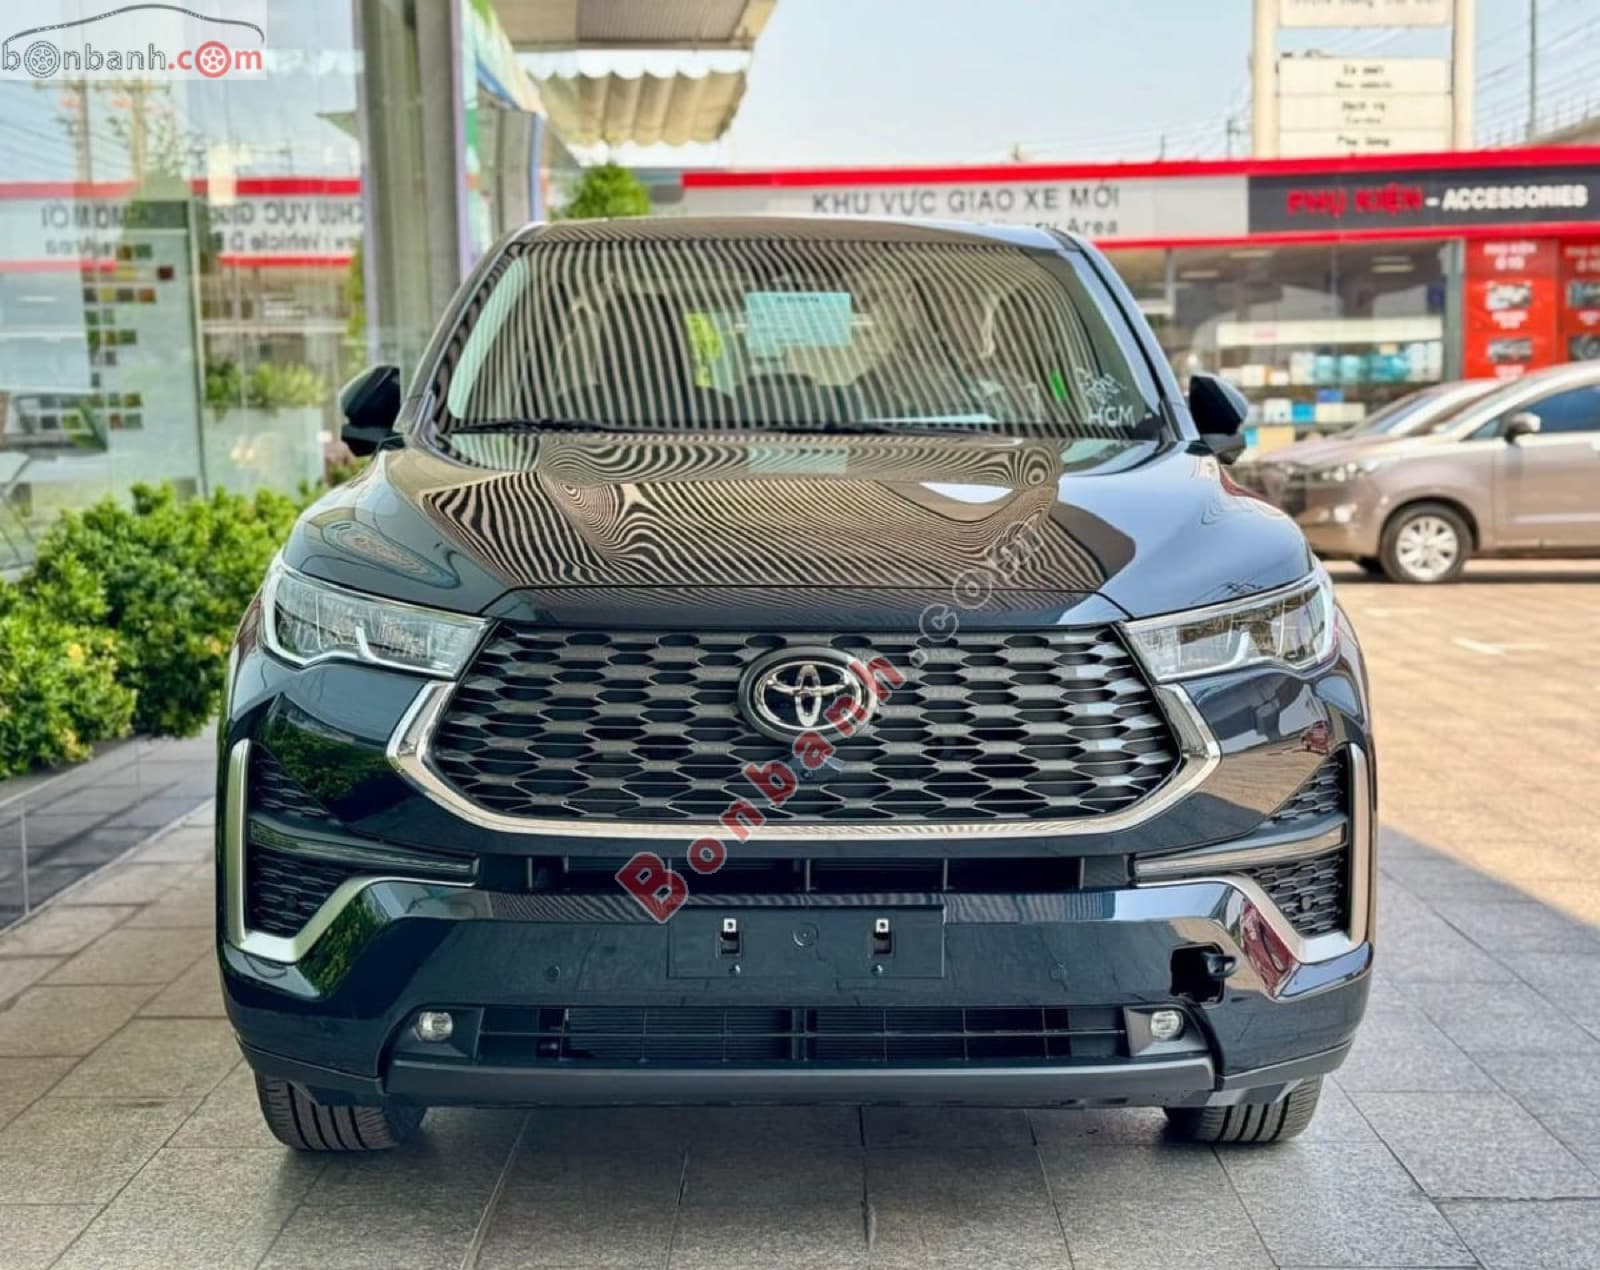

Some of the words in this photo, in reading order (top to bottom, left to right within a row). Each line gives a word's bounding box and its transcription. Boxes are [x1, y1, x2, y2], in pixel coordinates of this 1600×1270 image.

[812, 192, 870, 214] KHU
[882, 190, 937, 216] VỰC
[949, 189, 1015, 213] GIAO
[1024, 187, 1059, 210] XE
[1071, 181, 1120, 208] MỚI
[1442, 184, 1588, 211] ACCESSORIES
